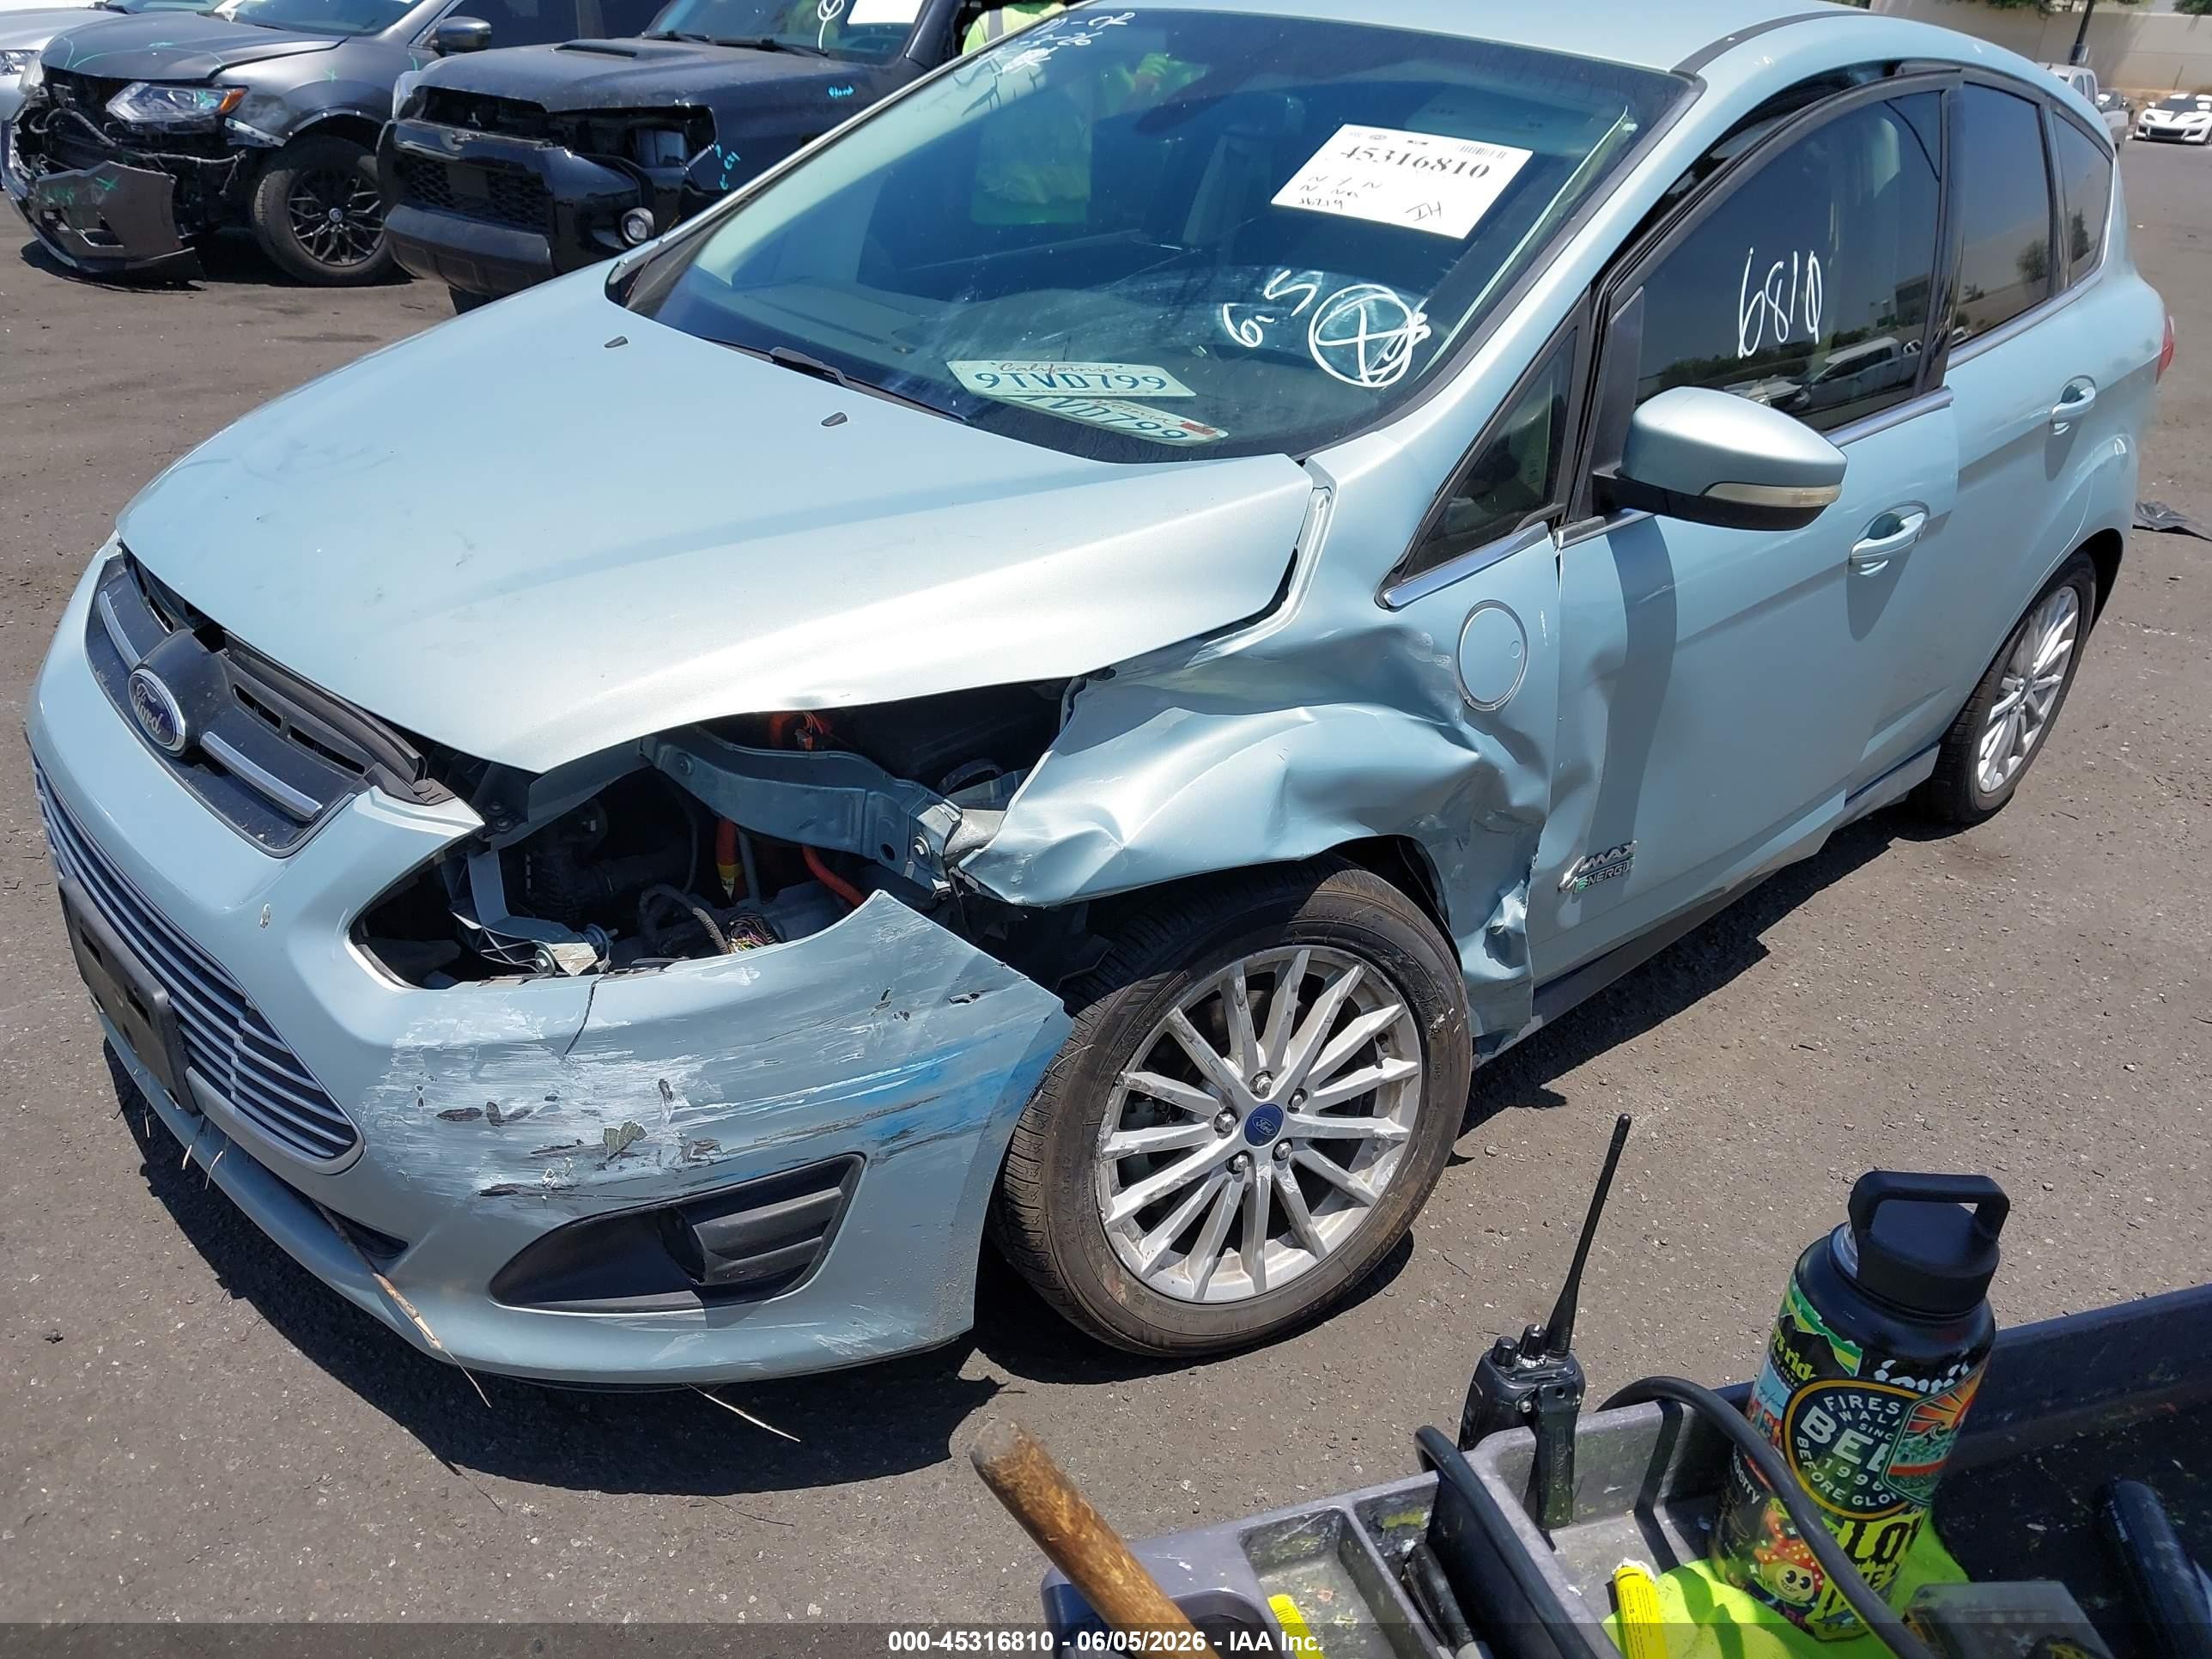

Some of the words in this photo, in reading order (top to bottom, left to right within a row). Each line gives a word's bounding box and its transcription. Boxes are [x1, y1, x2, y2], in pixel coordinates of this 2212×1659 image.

[1340, 145, 1491, 179] 45316810
[1737, 246, 1822, 360] 6810
[999, 362, 1118, 374] California
[975, 373, 1168, 390] 9TVD799
[132, 683, 165, 735] Ford
[1784, 1346, 1818, 1381] rid
[1823, 1395, 1901, 1415] FIRES
[1838, 1410, 1901, 1427] WAL
[1858, 1423, 1895, 1442] SINC
[1796, 1436, 1846, 1500] BEFORE
[1850, 1492, 1898, 1507] GLO
